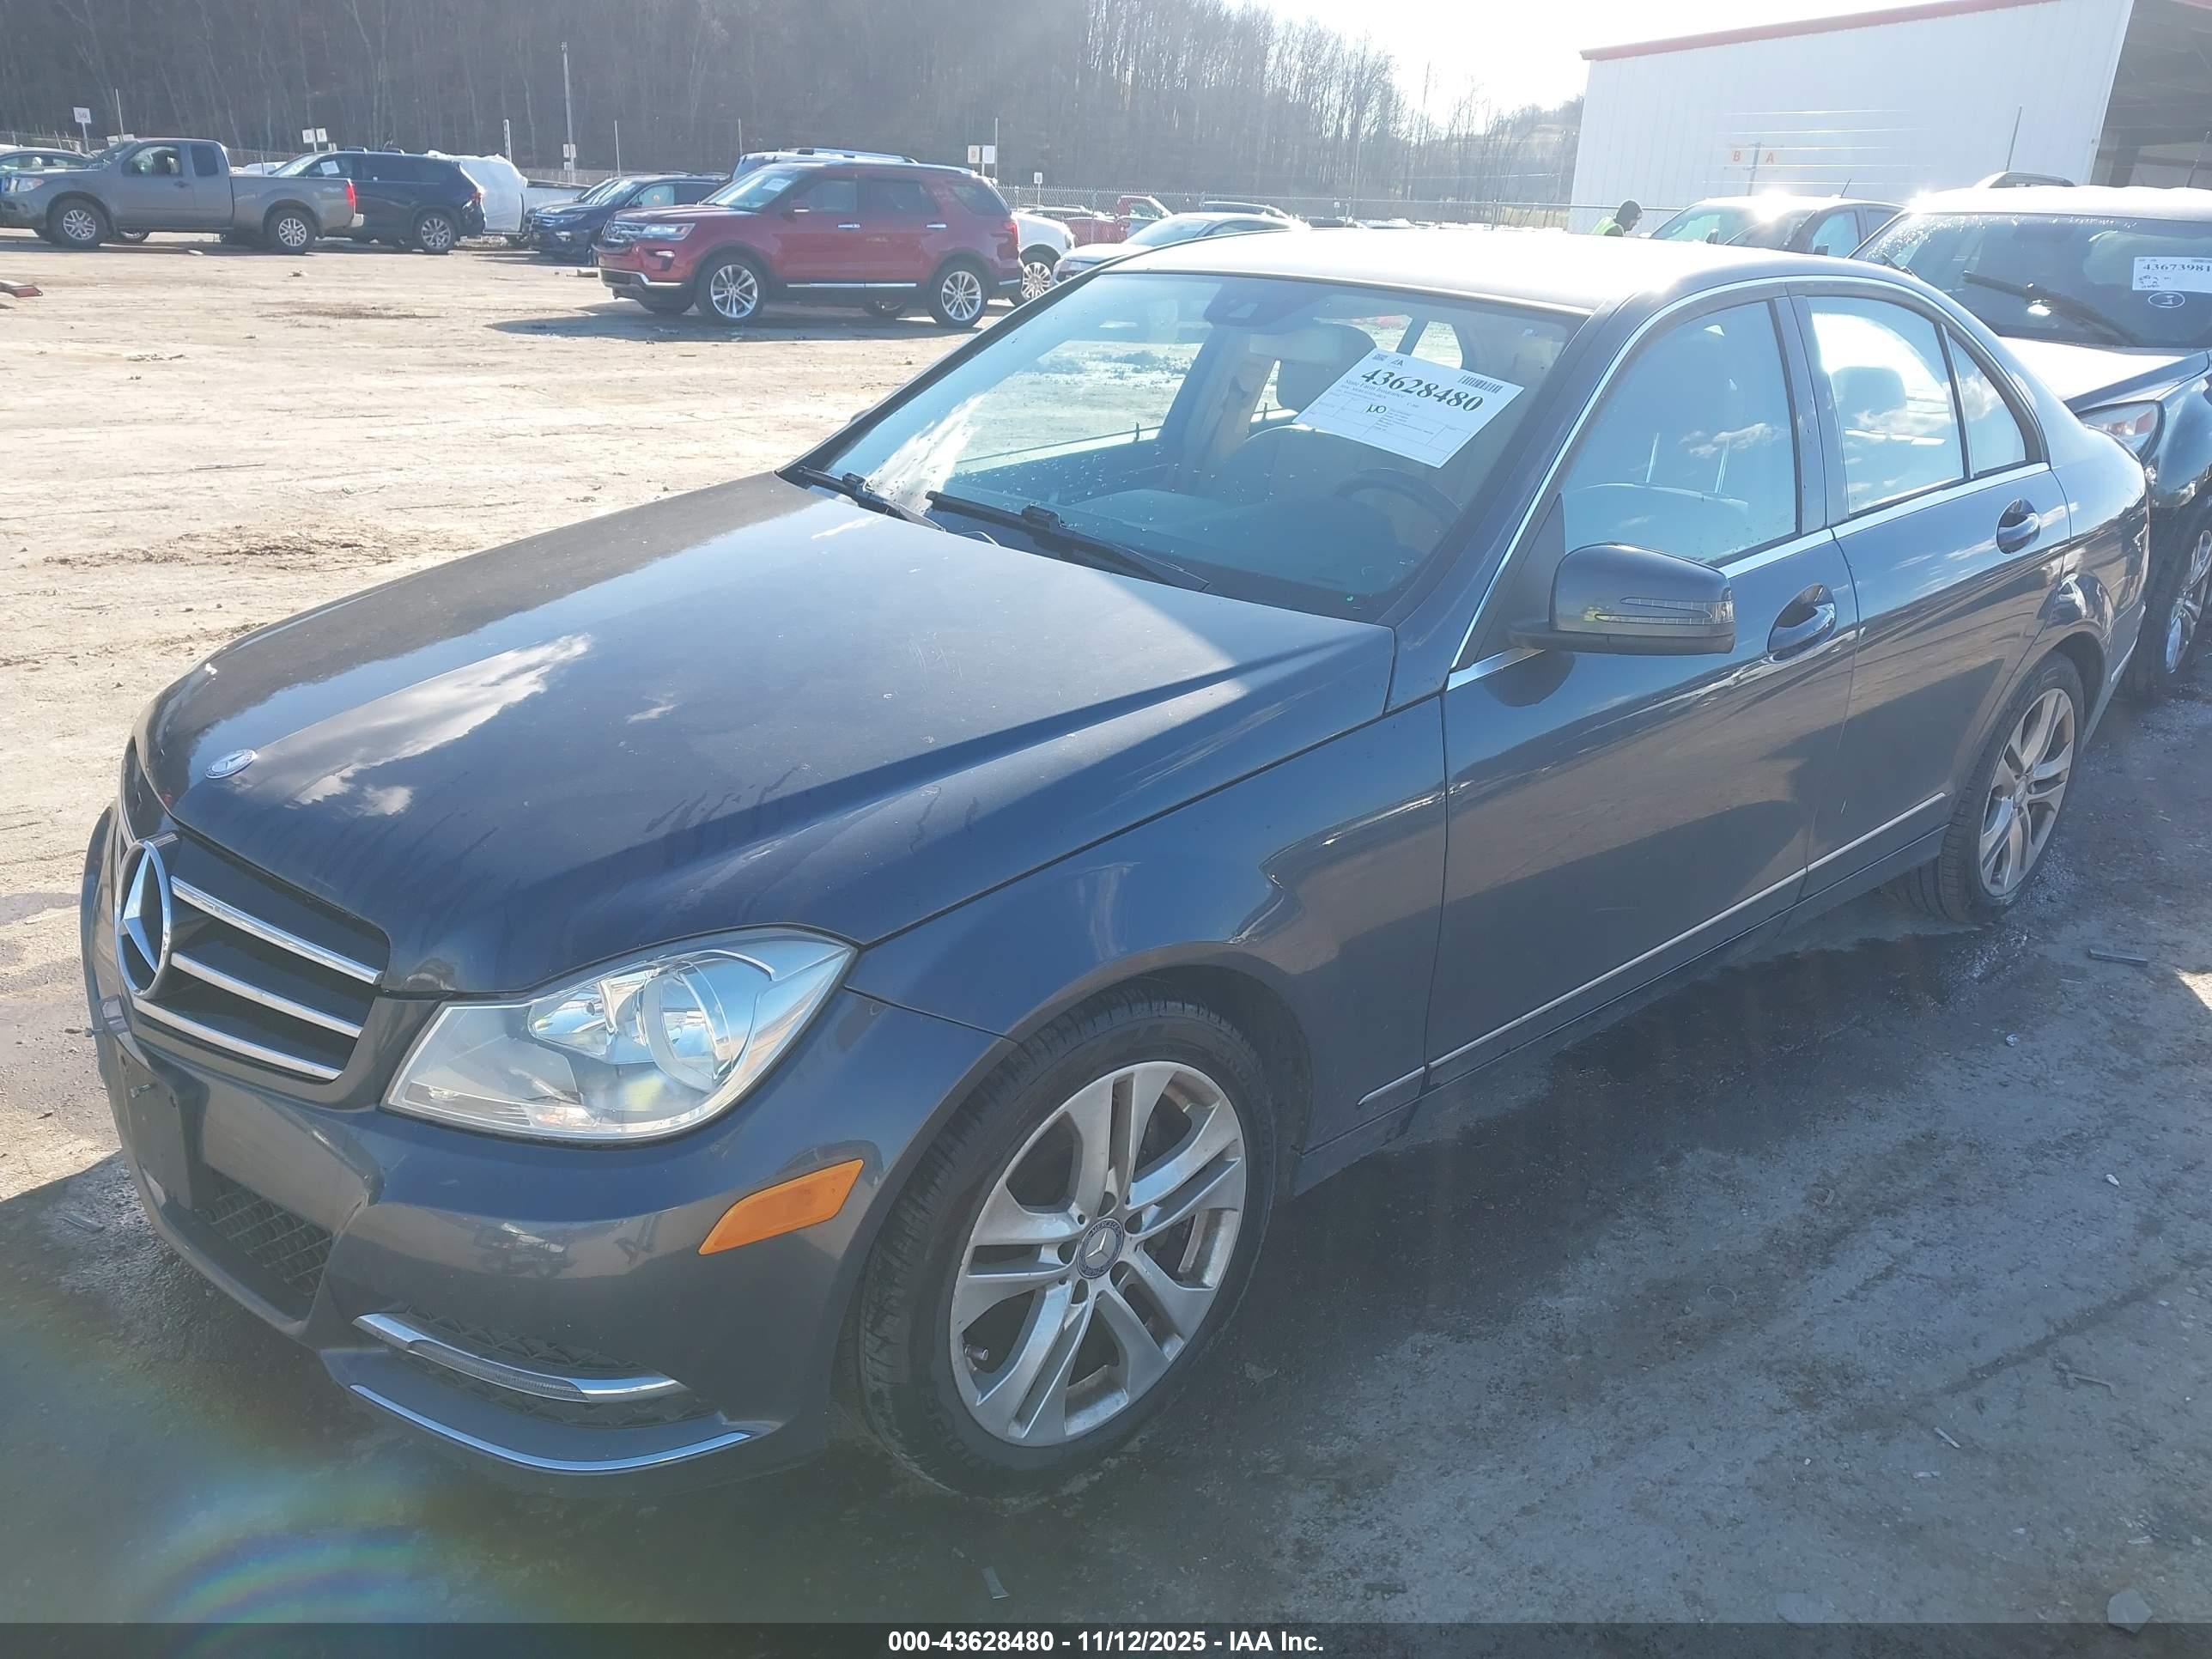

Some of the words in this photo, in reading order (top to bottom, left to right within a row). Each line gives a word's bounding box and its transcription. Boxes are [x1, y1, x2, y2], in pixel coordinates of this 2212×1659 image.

[1733, 150, 1741, 161] B
[1765, 152, 1774, 163] A
[2143, 264, 2211, 272] 43673981
[1361, 368, 1484, 411] 43628480
